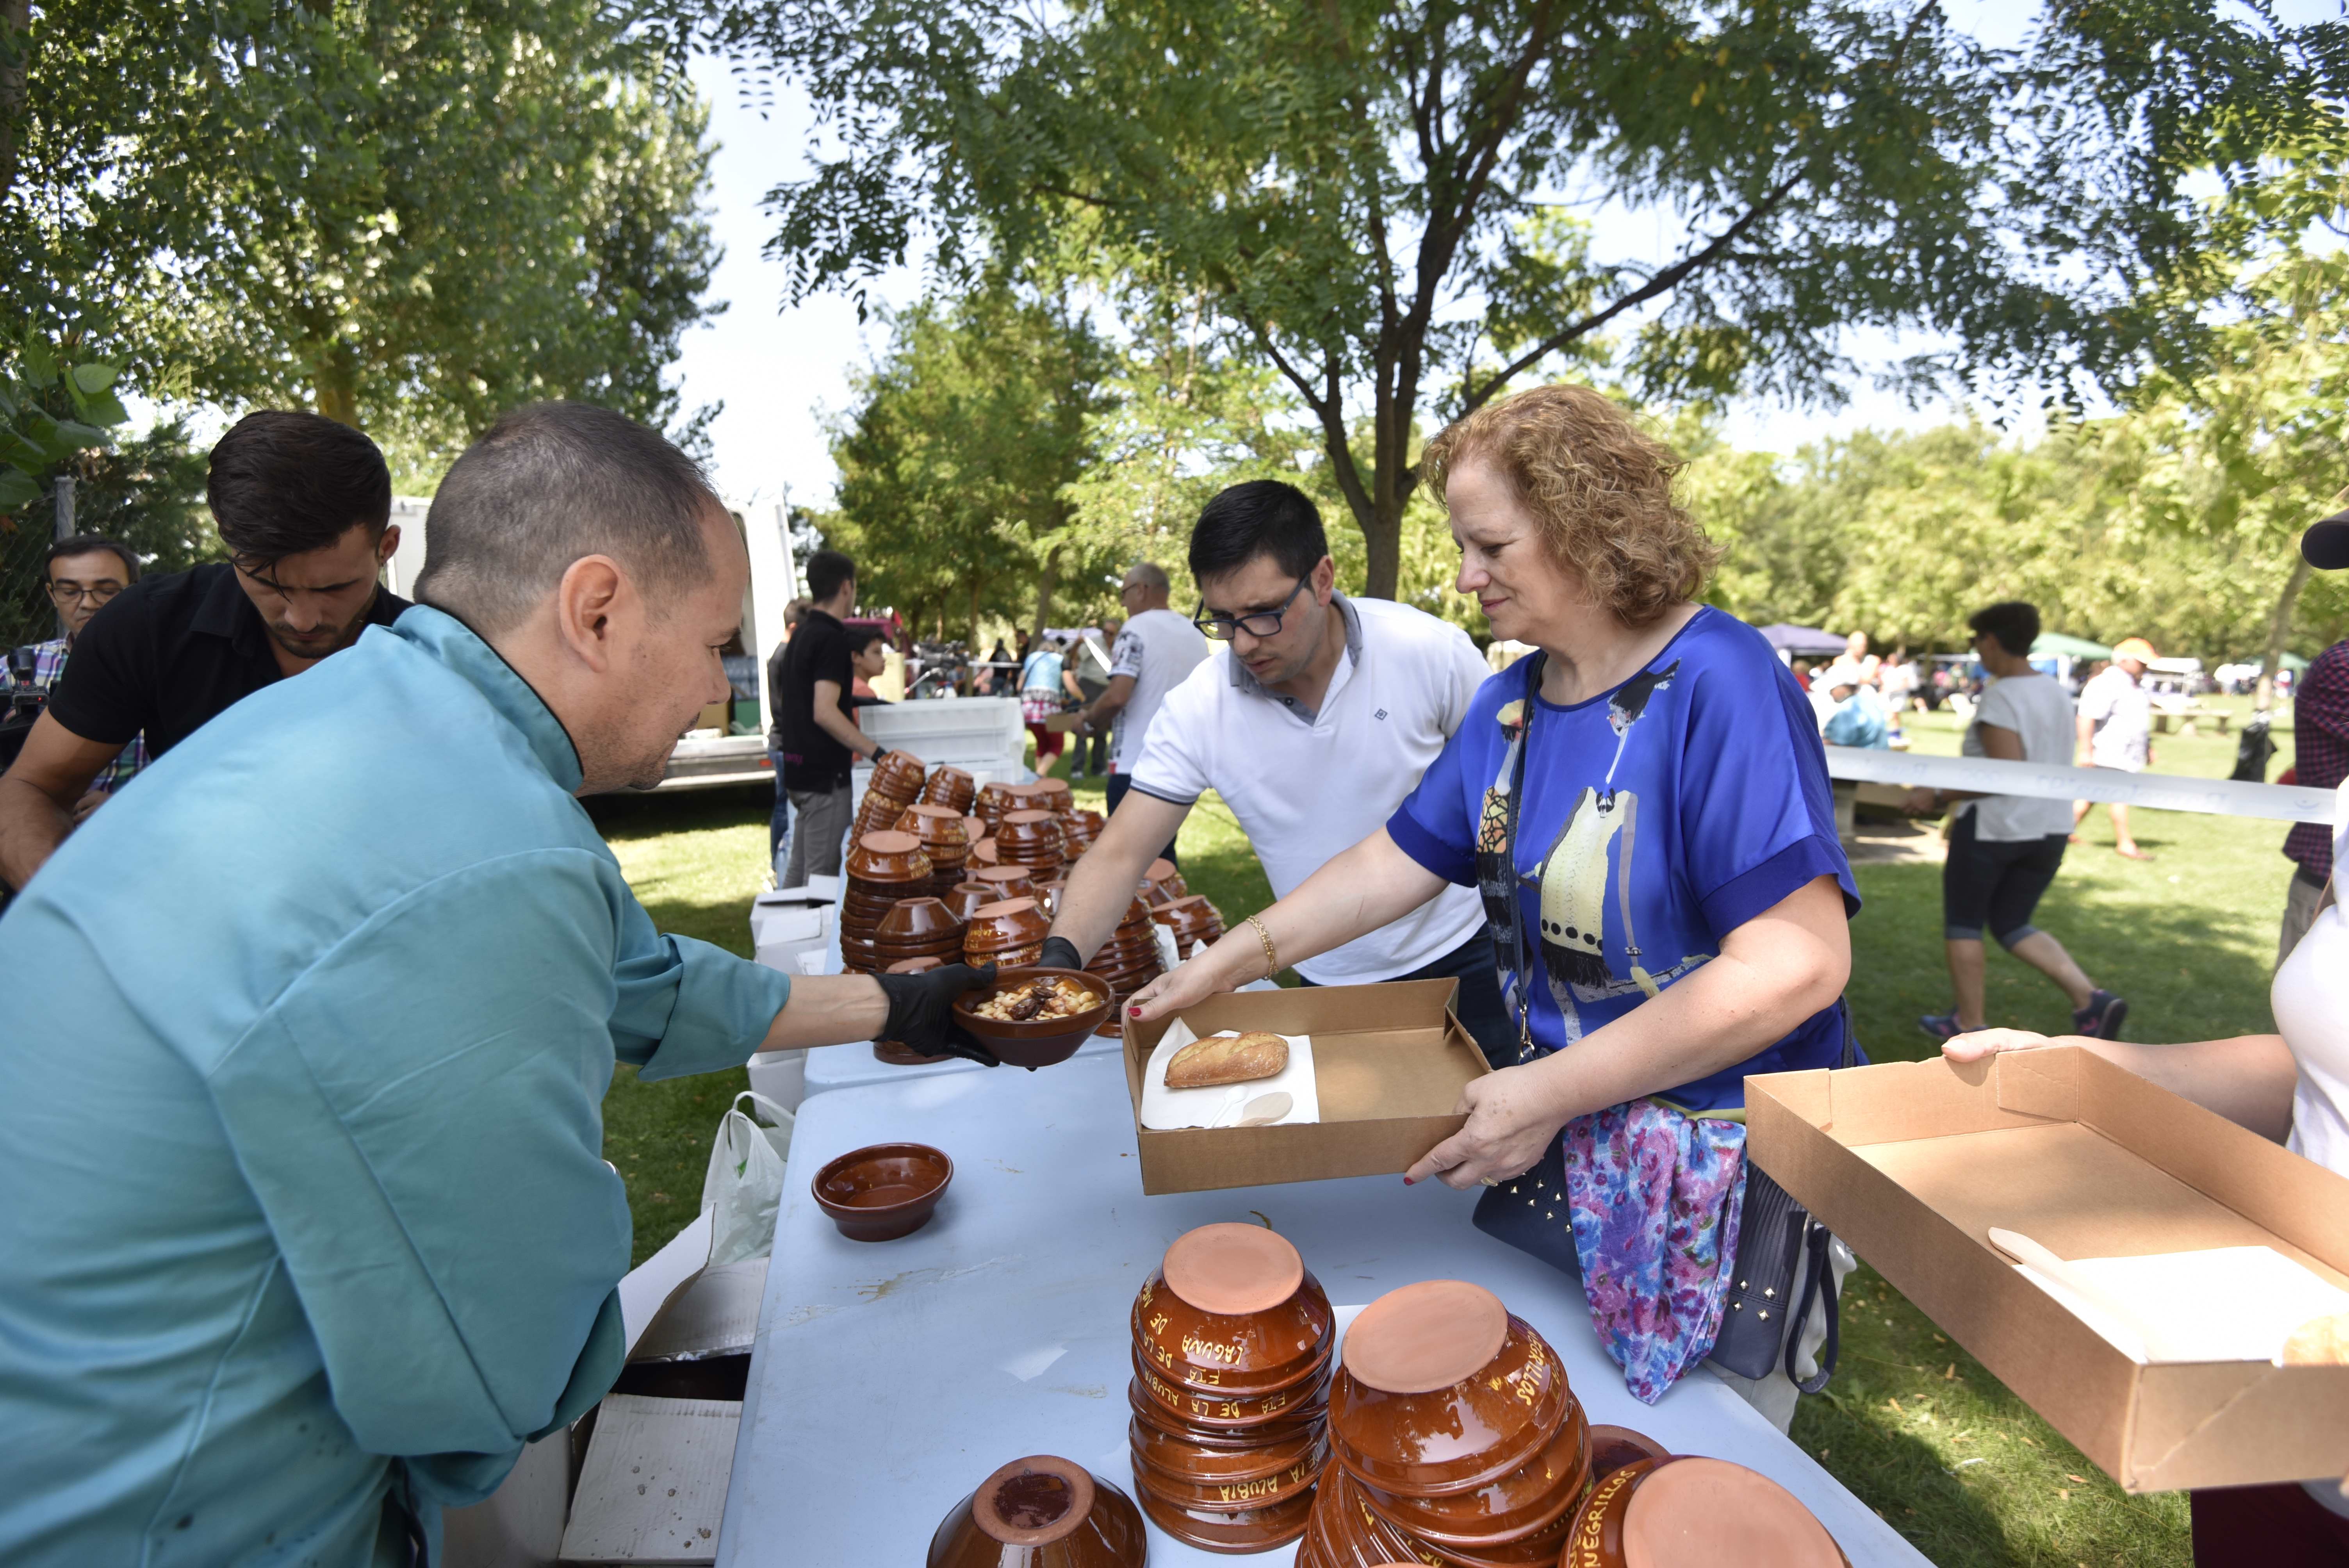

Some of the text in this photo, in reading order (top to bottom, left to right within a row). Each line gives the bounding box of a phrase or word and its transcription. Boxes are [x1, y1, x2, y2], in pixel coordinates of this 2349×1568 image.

[1144, 1332, 1154, 1354] LA
[1150, 1313, 1244, 1365] LAGUNA DE
[1156, 1346, 1172, 1369] DE
[1144, 1366, 1179, 1406] ALUBIA
[1191, 1399, 1209, 1416] LA
[1220, 1402, 1240, 1418] DE
[1289, 1461, 1305, 1483] LA
[1219, 1474, 1278, 1504] ALUBIA
[1583, 1470, 1636, 1568] NEGRILLOS
